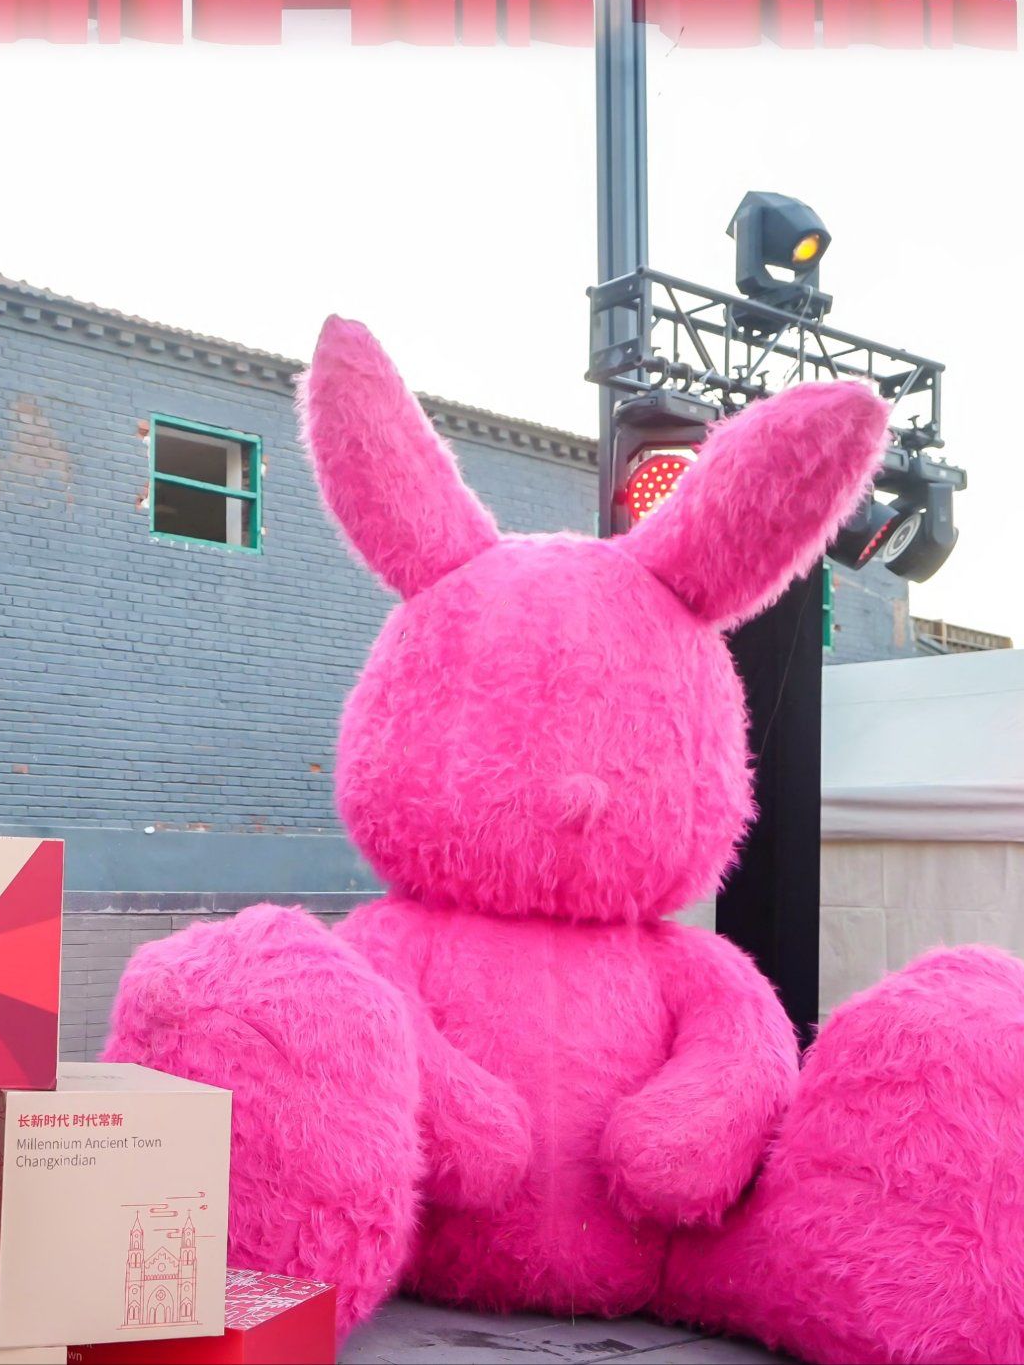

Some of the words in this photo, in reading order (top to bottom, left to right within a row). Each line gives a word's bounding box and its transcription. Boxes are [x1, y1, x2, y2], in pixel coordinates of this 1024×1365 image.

[18, 1114, 70, 1128] 长新时代
[72, 1113, 123, 1127] 时代常新
[16, 1137, 82, 1150] Millennium
[84, 1136, 128, 1149] Ancient
[131, 1135, 162, 1148] Town
[16, 1154, 96, 1170] Changxindian
